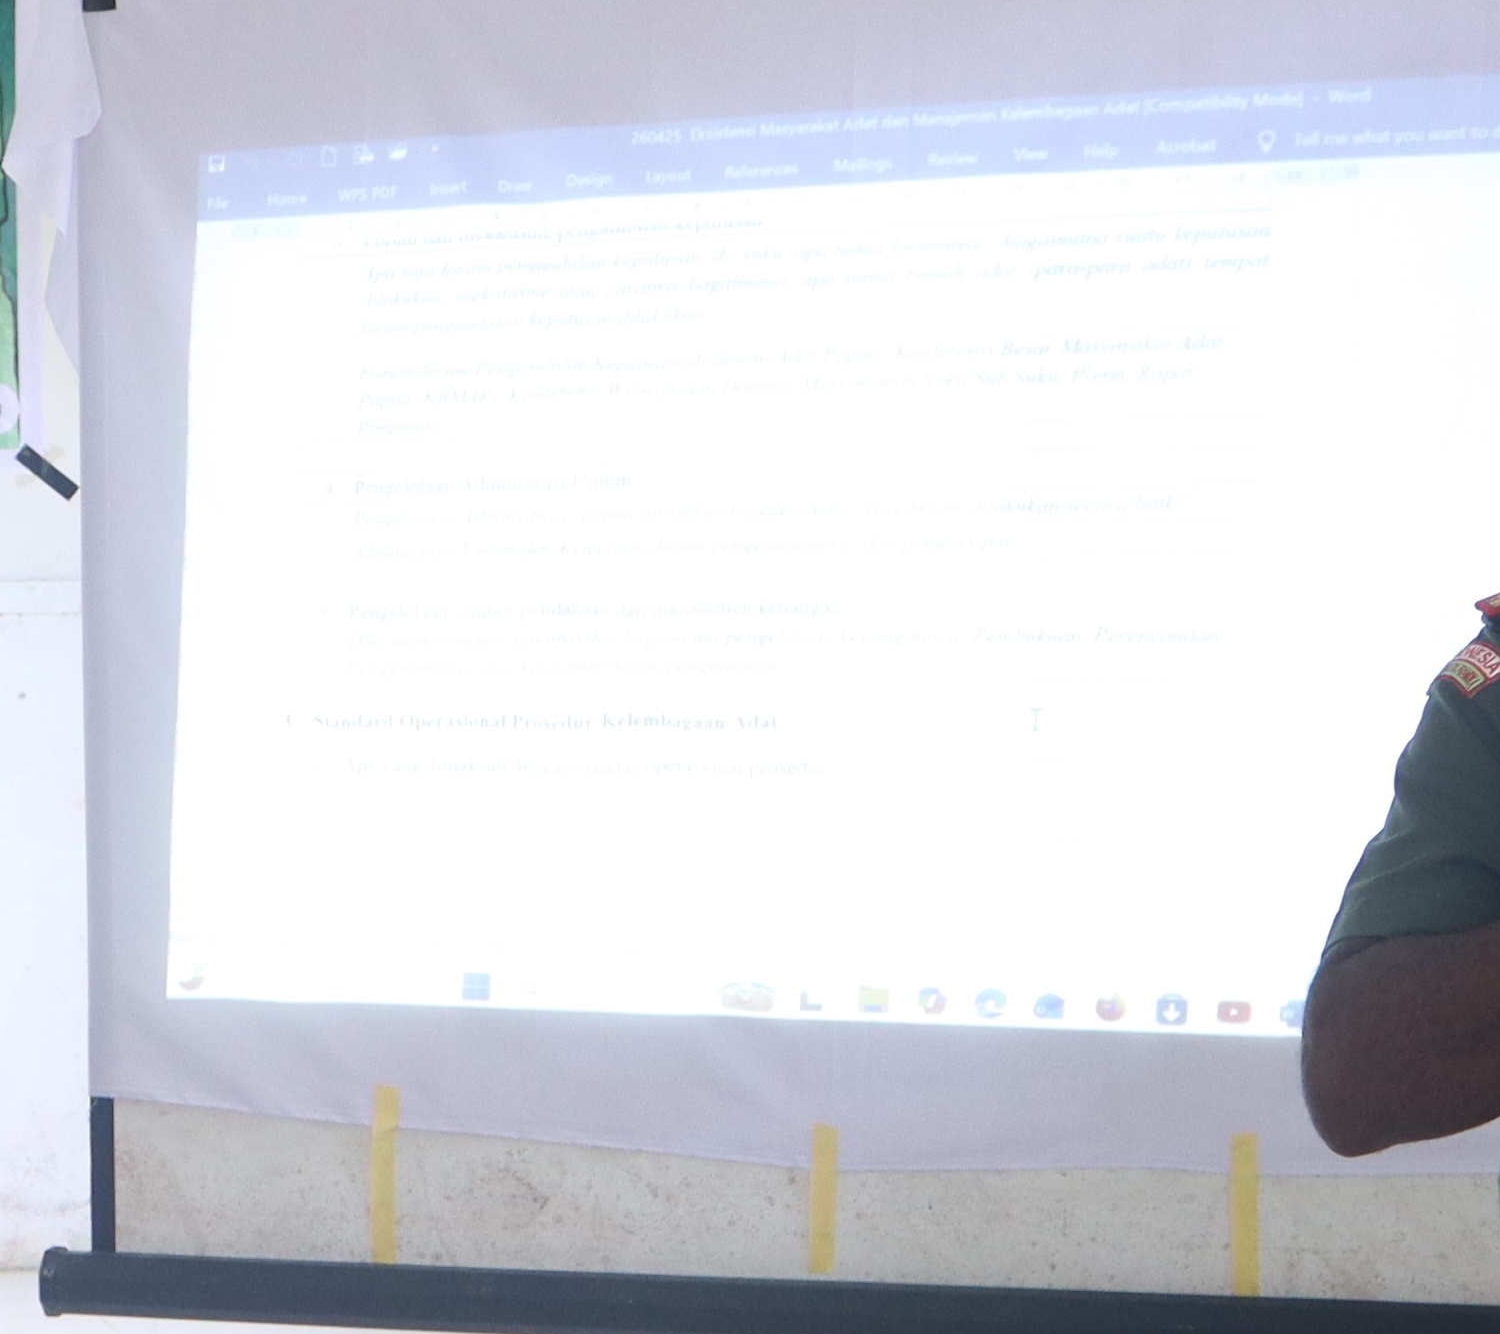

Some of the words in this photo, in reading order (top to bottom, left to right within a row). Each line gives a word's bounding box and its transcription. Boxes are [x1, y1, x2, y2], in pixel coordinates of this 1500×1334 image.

[1329, 88, 1375, 104] Word
[1296, 132, 1321, 146] Tell
[1325, 134, 1350, 146] me
[1353, 130, 1391, 145] what
[1396, 130, 1425, 146] you
[1428, 127, 1465, 141] want
[1469, 125, 1489, 139] to
[208, 196, 228, 210] File
[268, 192, 308, 206] Home
[339, 188, 368, 202] WPS
[371, 185, 398, 200] PDF
[431, 180, 467, 195] Insert
[498, 179, 532, 193] Draw
[566, 172, 614, 189] Design
[645, 169, 691, 186] Layout
[928, 151, 979, 166] Review
[1084, 144, 1119, 160] Help
